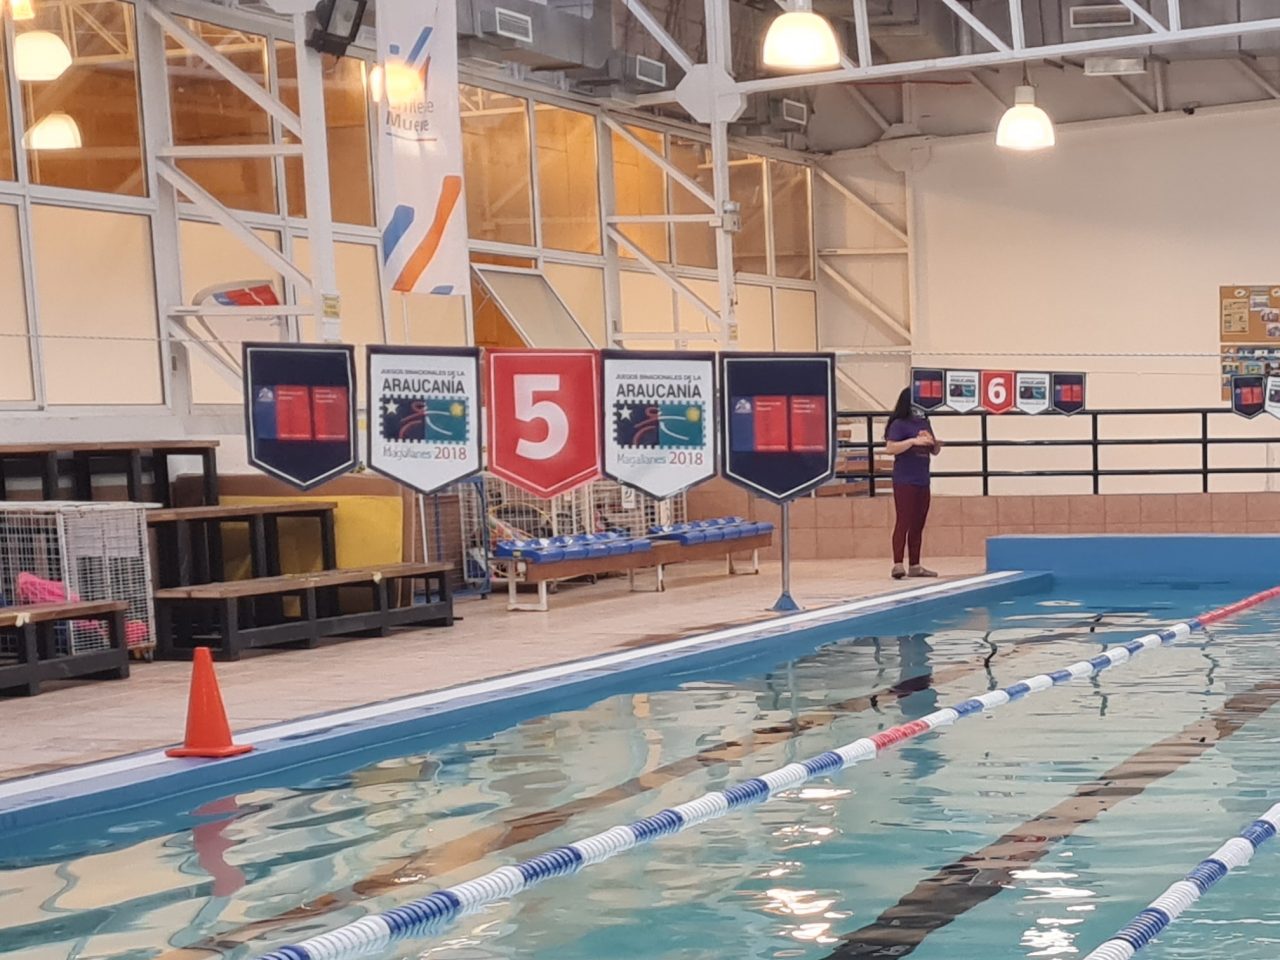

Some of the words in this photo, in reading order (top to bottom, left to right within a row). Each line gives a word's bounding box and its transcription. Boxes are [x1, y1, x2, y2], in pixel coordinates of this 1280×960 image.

[382, 375, 466, 394] ARAUCANÍA
[616, 380, 702, 398] ARAUCANÍA
[987, 377, 1007, 405] 6
[513, 373, 569, 460] 5
[434, 446, 467, 460] 2018
[669, 451, 703, 465] 2018
